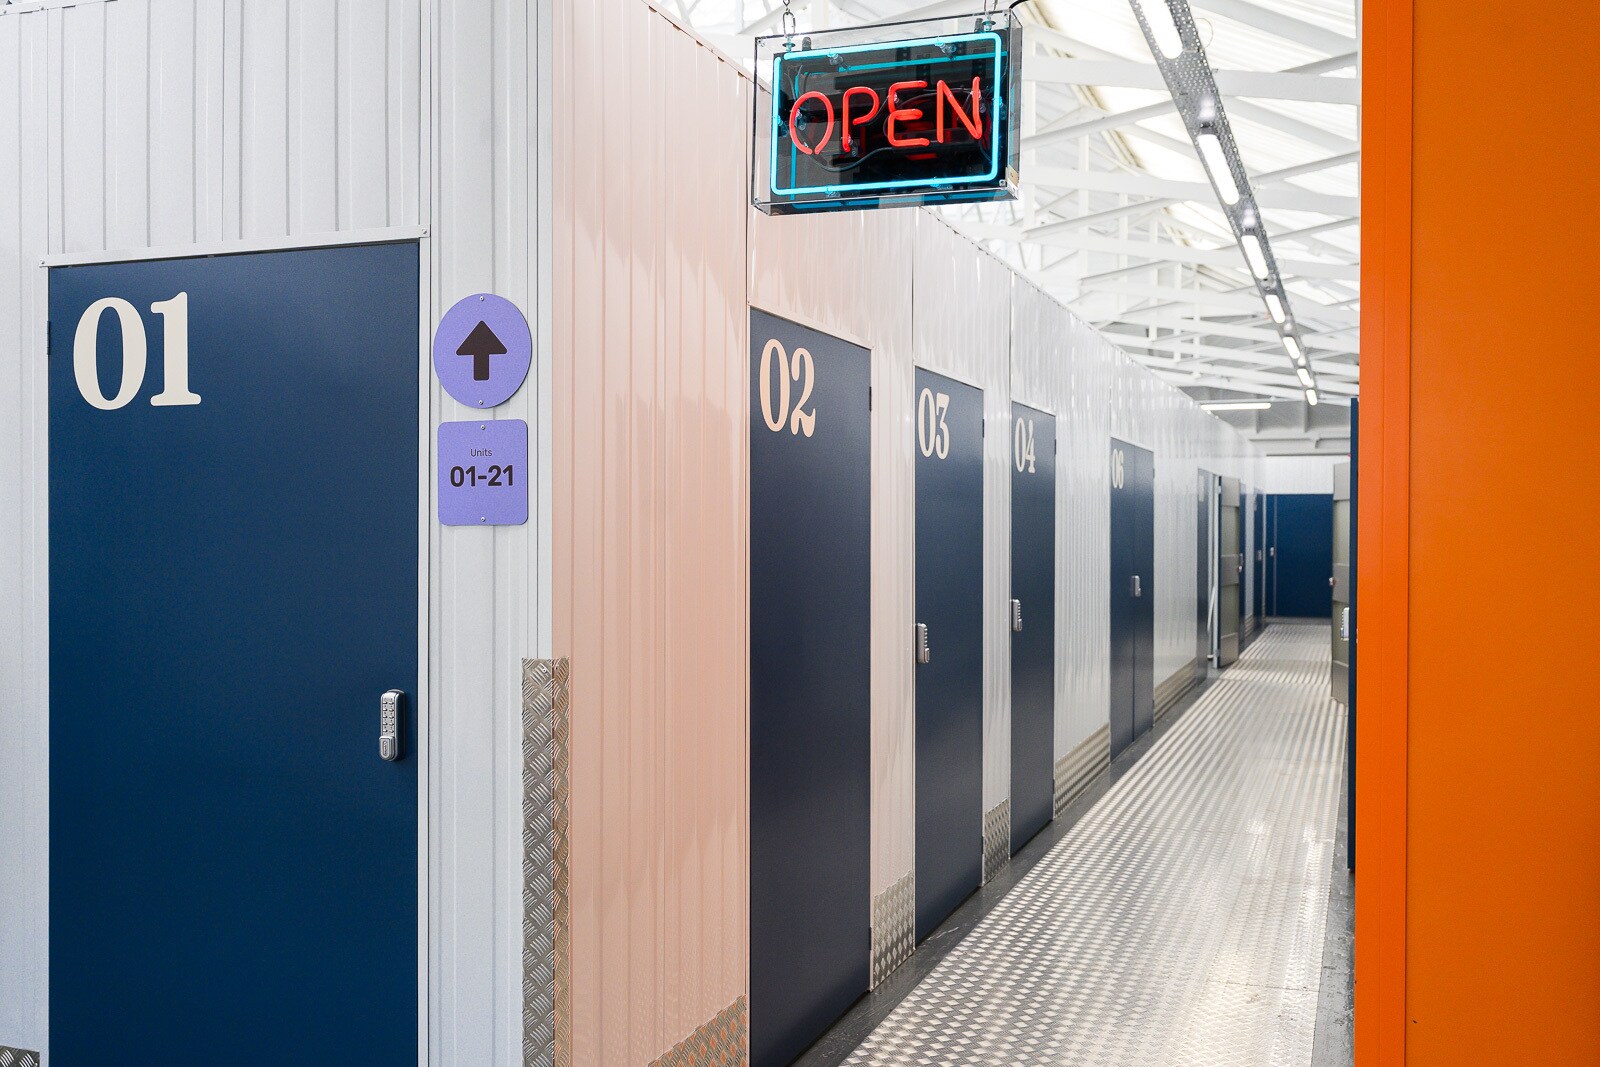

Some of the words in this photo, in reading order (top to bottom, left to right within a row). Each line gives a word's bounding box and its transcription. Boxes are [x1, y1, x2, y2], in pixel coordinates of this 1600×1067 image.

[789, 76, 983, 155] OPEN
[73, 291, 202, 410] 01
[759, 338, 816, 438] 02
[470, 448, 493, 457] Units
[918, 388, 950, 460] 03
[1014, 417, 1036, 474] 04
[450, 465, 514, 488] 01-21
[1111, 449, 1124, 490] 06
